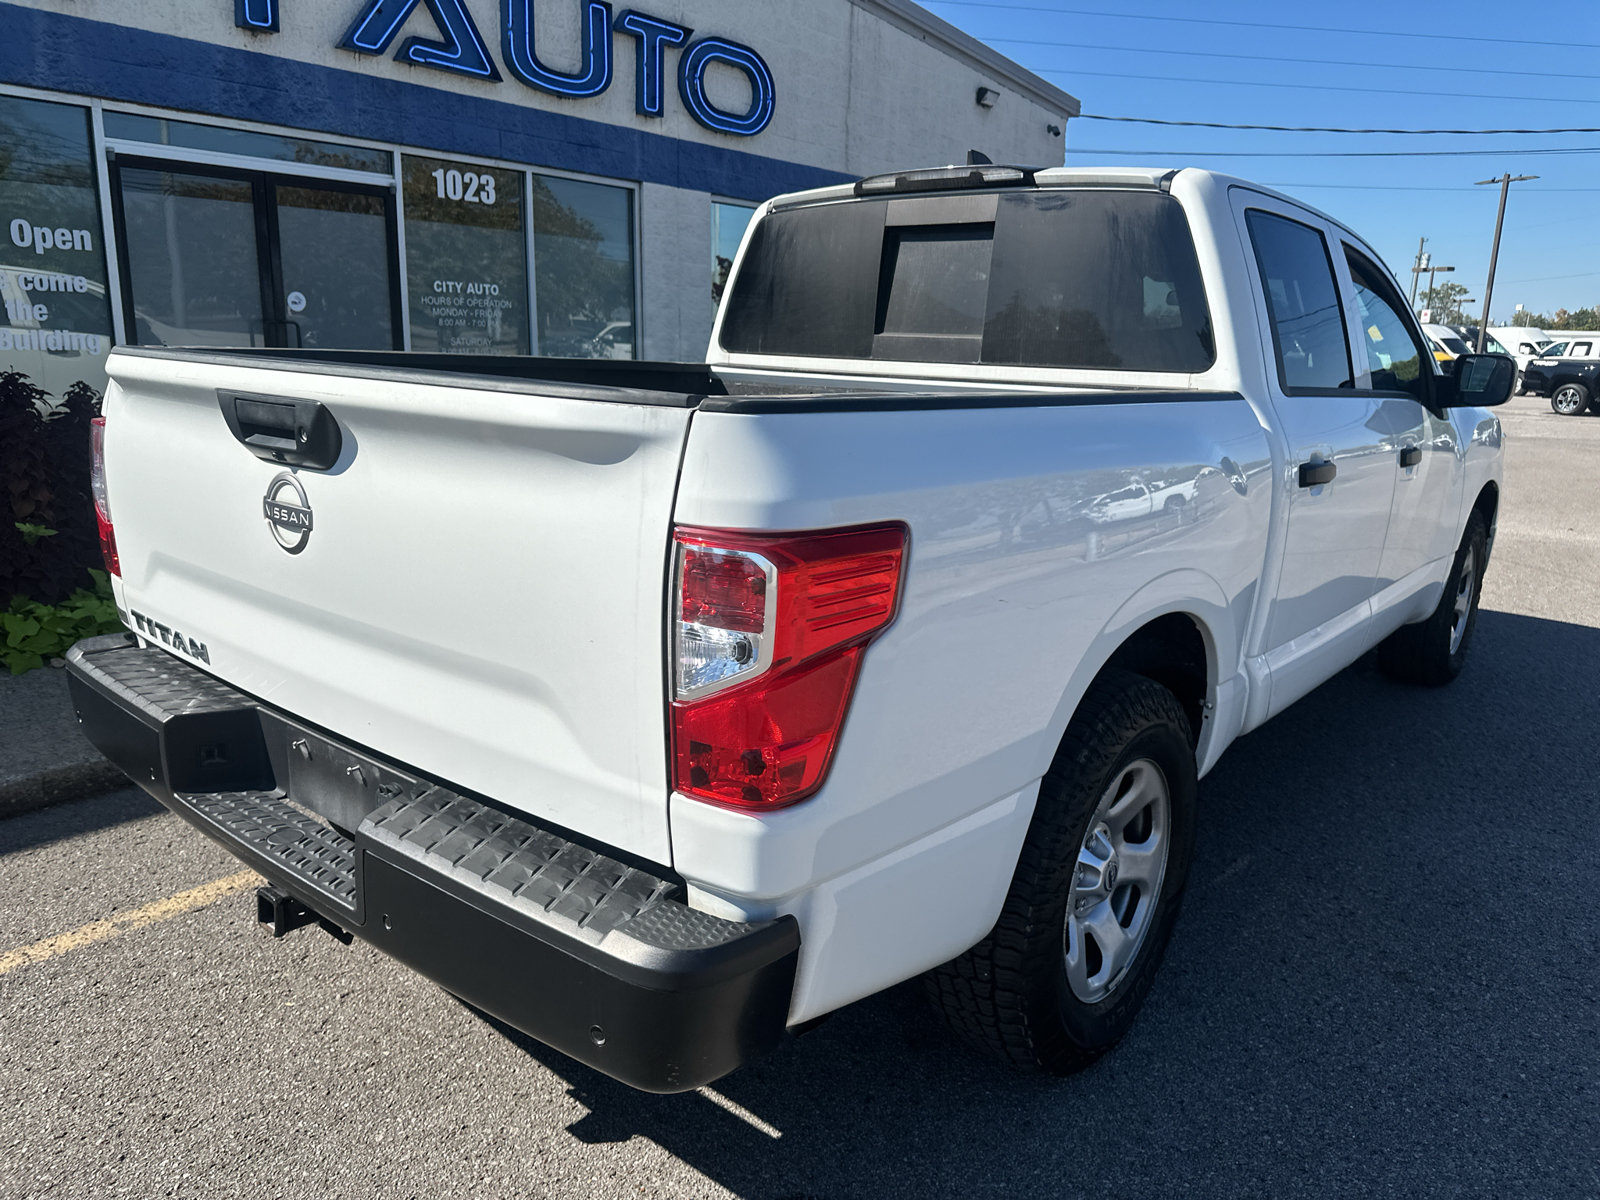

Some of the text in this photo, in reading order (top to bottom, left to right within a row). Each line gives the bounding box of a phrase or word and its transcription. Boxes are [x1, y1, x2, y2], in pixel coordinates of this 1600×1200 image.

[335, 0, 776, 137] AUTO
[431, 168, 496, 205] 1023
[10, 218, 93, 255] Open
[18, 273, 88, 293] come
[433, 280, 500, 296] CITY AUTO
[5, 298, 48, 322] the
[421, 296, 513, 310] HOURS OF OPERATION
[432, 308, 468, 318] MONDAY
[474, 309, 503, 319] FRIDAY
[454, 318, 466, 327] AM
[0, 329, 101, 355] Building
[450, 336, 493, 347] SATURDAY
[265, 503, 309, 526] NISSAN
[130, 608, 211, 666] TITAN
